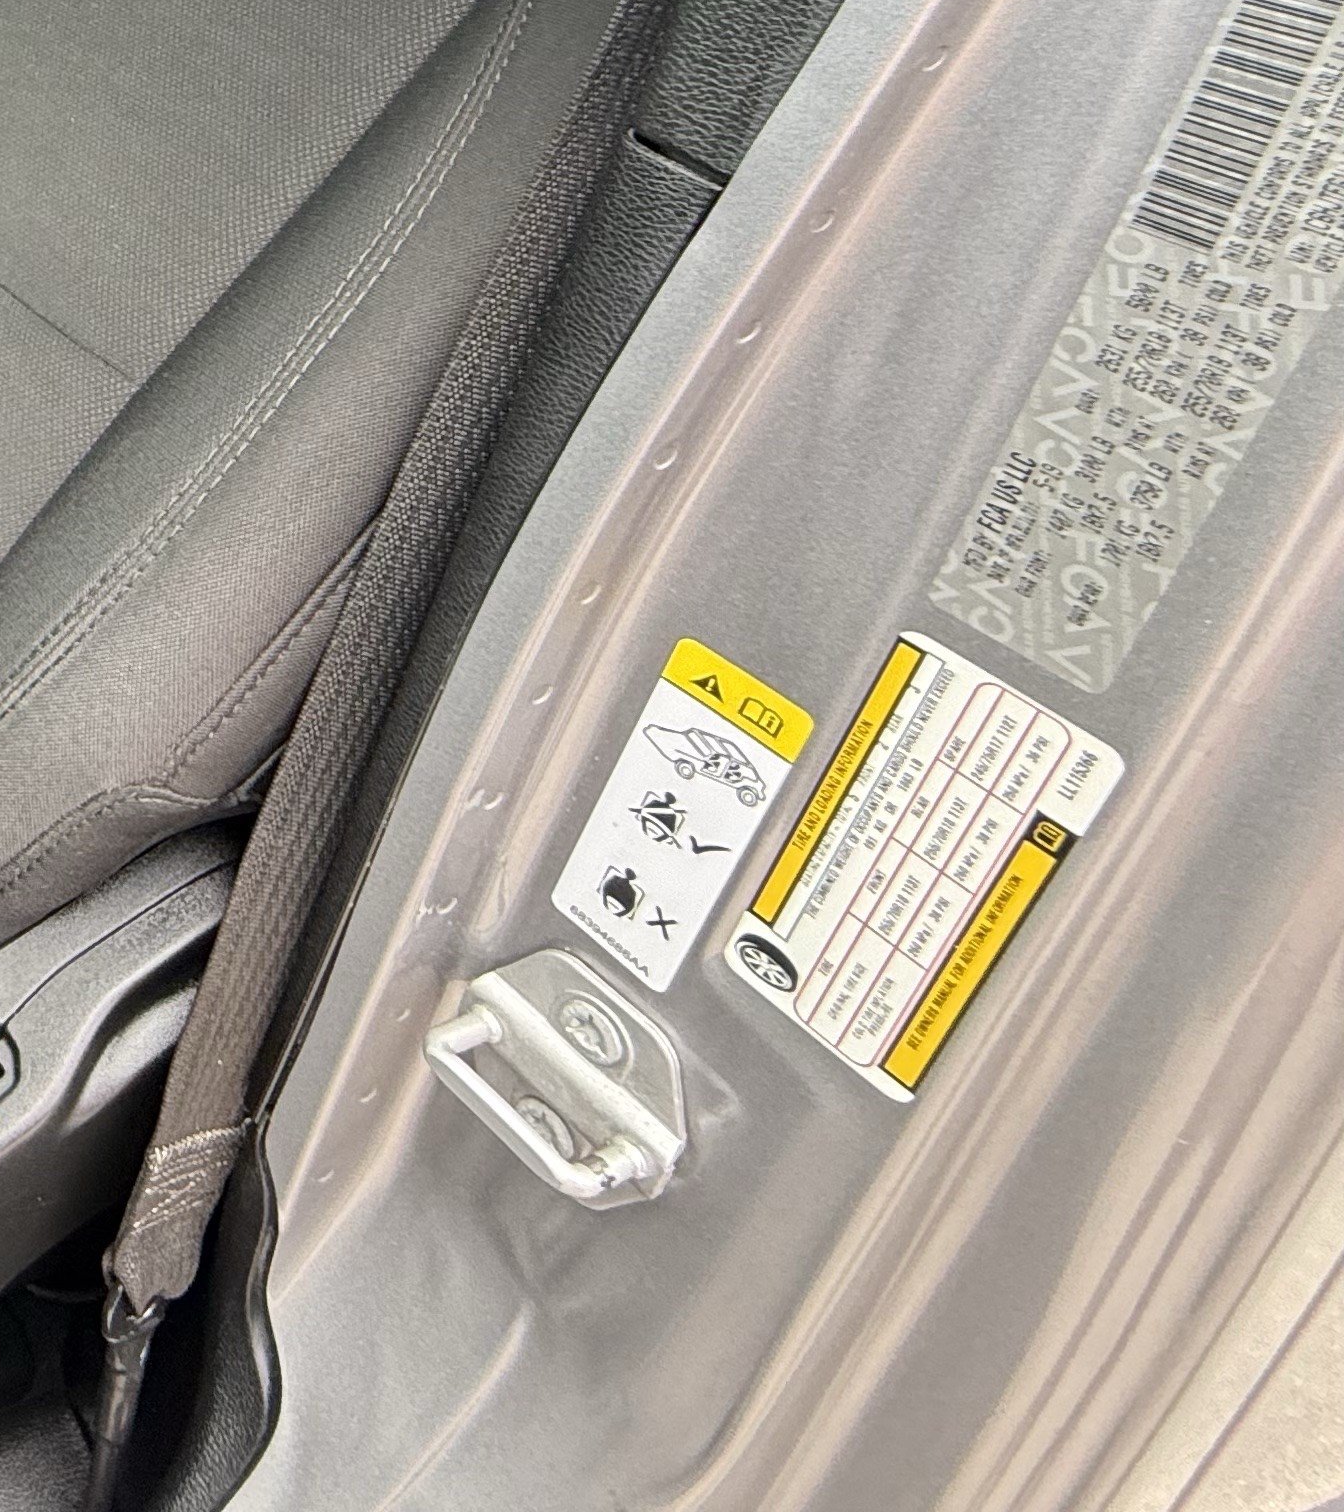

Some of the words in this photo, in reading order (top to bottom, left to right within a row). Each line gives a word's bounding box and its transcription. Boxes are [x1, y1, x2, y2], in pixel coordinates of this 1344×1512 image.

[1232, 199, 1271, 241] VEHICLE
[1260, 188, 1309, 246] PREVENTION
[1139, 260, 1171, 284] LB
[1219, 238, 1250, 265] THIS
[1109, 320, 1138, 346] KG
[1094, 338, 1129, 376] 2631
[1001, 445, 1037, 488] LLC
[1031, 457, 1064, 498] 5-19
[1057, 487, 1085, 517] KG
[1088, 431, 1116, 458] LB
[990, 472, 1023, 511] US
[1112, 513, 1141, 544] KG
[1143, 456, 1174, 487] LB
[975, 492, 1012, 540] FCA
[830, 715, 875, 779] INFORMATION
[875, 773, 894, 794] AND
[929, 666, 957, 700] EXCEED
[811, 773, 842, 815] LOADING
[909, 794, 931, 819] REAR
[942, 734, 967, 763] SPARE
[791, 827, 812, 853] TIRE
[801, 809, 822, 833] AND
[956, 919, 993, 967] ADDITIONAL
[946, 959, 968, 982] FOR
